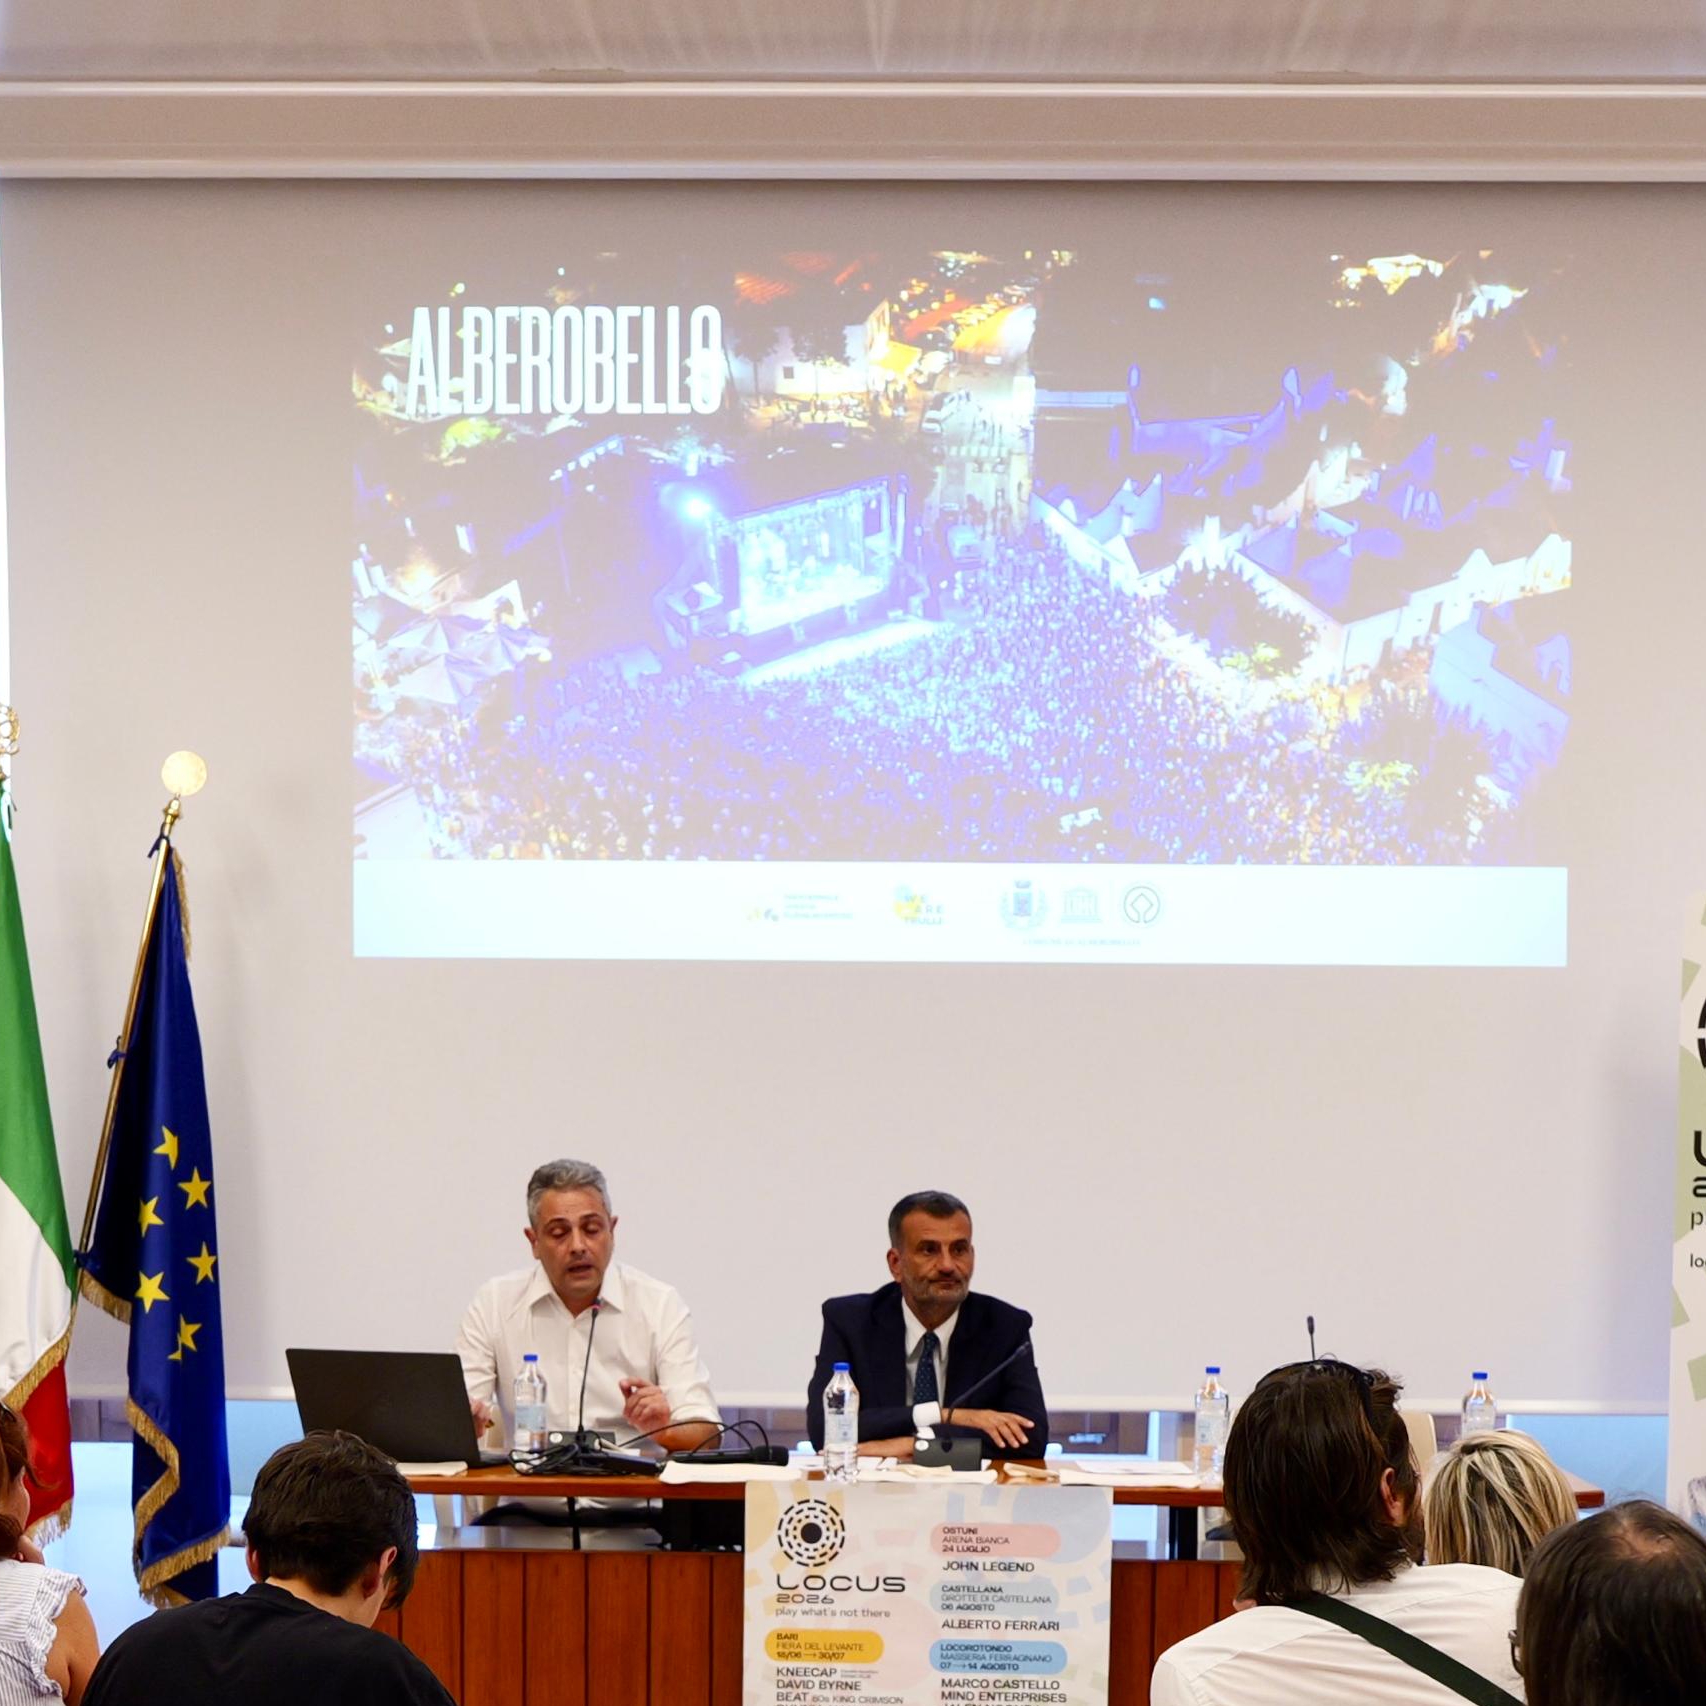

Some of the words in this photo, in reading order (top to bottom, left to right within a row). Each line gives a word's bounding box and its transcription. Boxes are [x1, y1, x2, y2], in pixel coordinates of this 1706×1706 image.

[405, 305, 722, 415] ALBEROBELLO
[943, 1526, 978, 1534] OSTUNI
[943, 1536, 973, 1544] ARENA
[976, 1536, 1011, 1544] BIANCA
[943, 1560, 979, 1571] JOHN
[983, 1562, 1035, 1572] LEGEND
[777, 1574, 906, 1592] LOCUS
[942, 1585, 1003, 1594] CASTELLANA
[776, 1594, 835, 1604] 2026
[775, 1607, 797, 1618] play
[801, 1608, 837, 1617] what's
[840, 1609, 858, 1617] not
[861, 1609, 891, 1618] there
[942, 1619, 1001, 1630] ALBERTO
[1005, 1620, 1059, 1630] FERRARI
[824, 1644, 864, 1652] LEVANTE
[941, 1644, 1013, 1652] LOCOROTONDO
[980, 1662, 1019, 1670] AGOSTO
[777, 1667, 837, 1678] KNEECAP
[777, 1680, 815, 1689] DAVID
[819, 1681, 861, 1690] BYRNE
[941, 1678, 989, 1689] MARCO
[993, 1680, 1060, 1690] CASTELLO
[777, 1692, 809, 1702] BEAT
[859, 1696, 903, 1704] CRIMSON
[941, 1691, 975, 1701] MIND
[979, 1692, 1067, 1703] ENTERPRISES
